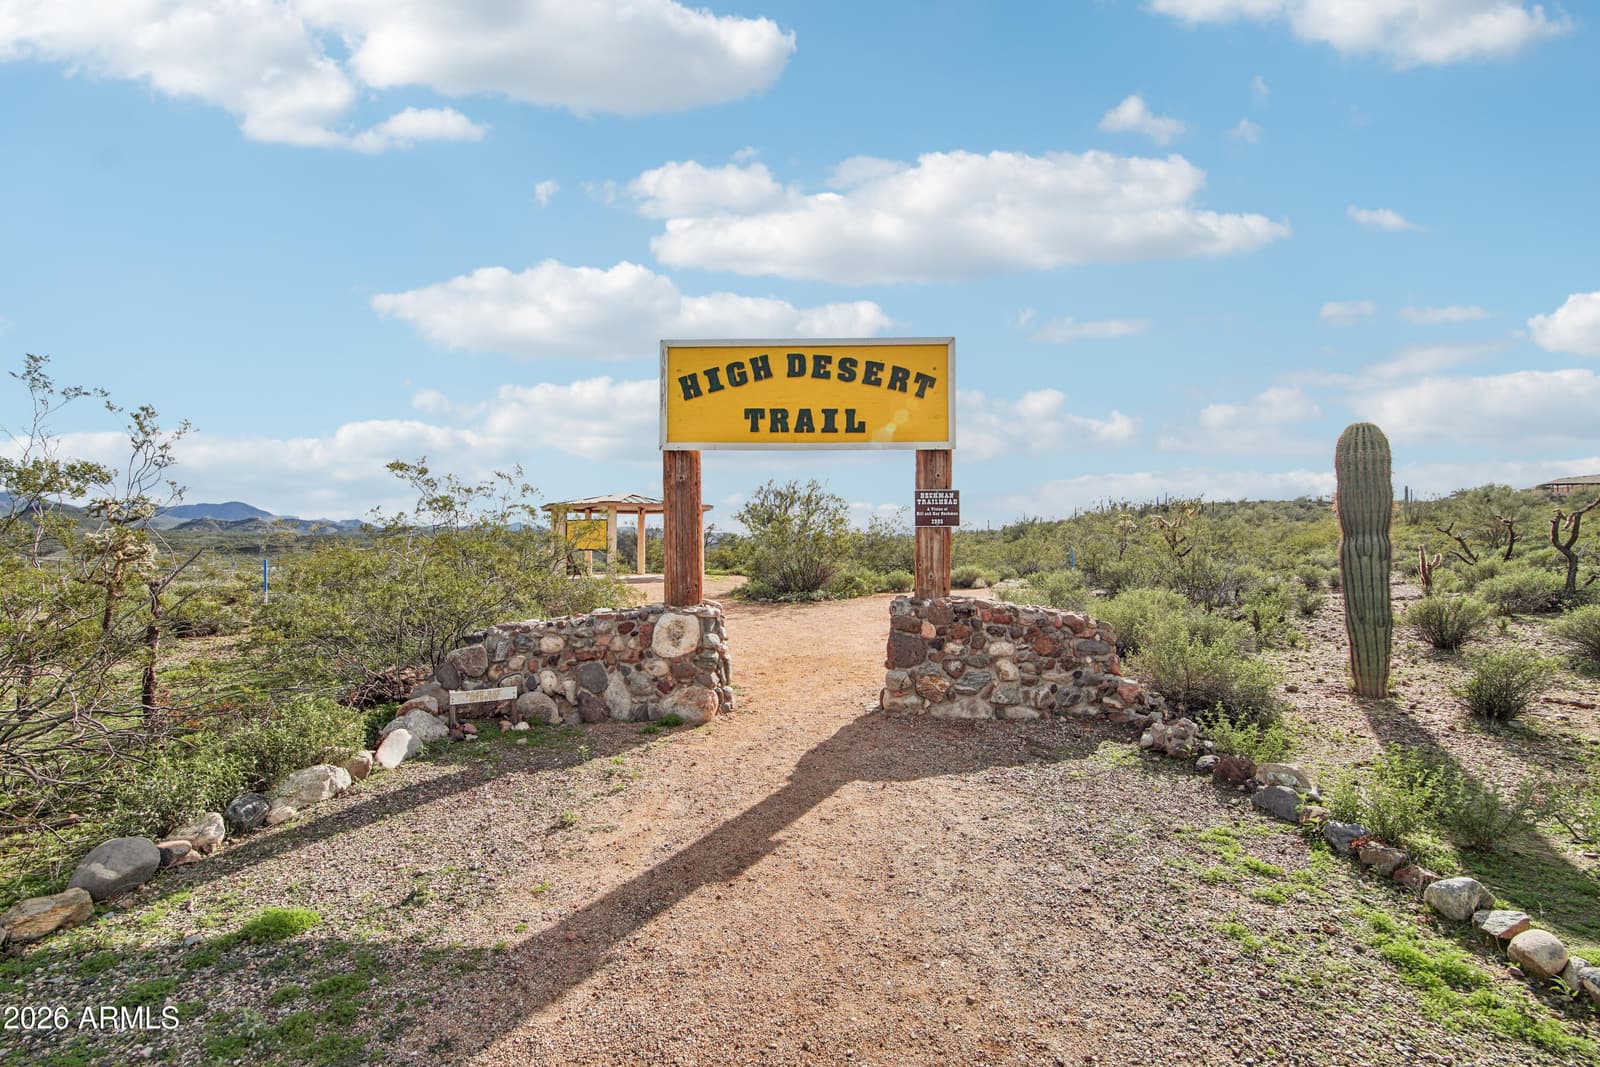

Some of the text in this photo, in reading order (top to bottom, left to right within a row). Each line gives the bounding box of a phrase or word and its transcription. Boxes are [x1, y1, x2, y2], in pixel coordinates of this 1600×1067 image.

[678, 353, 936, 400] HIGH DESERT
[744, 408, 866, 433] TRAIL
